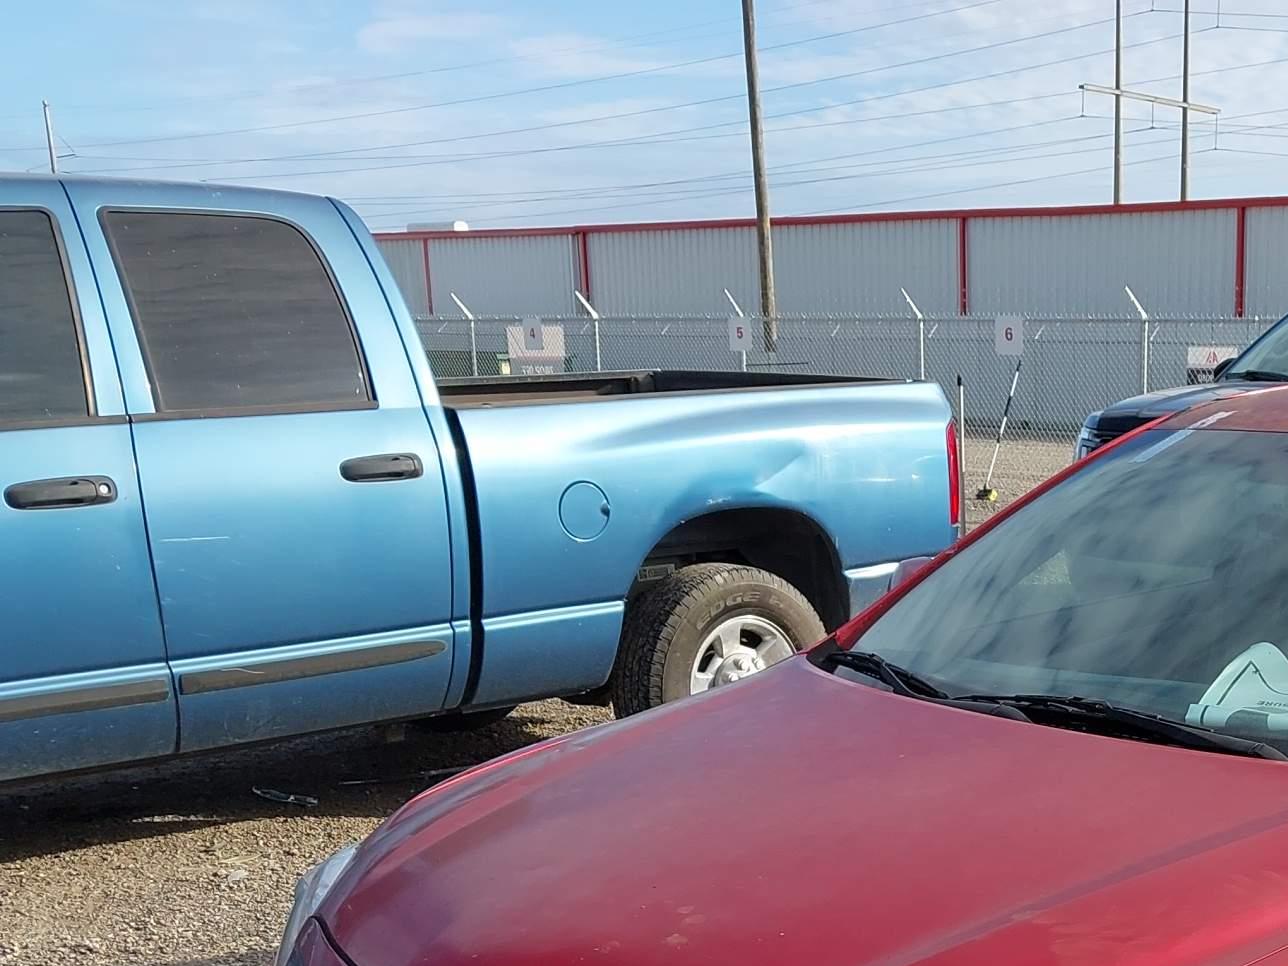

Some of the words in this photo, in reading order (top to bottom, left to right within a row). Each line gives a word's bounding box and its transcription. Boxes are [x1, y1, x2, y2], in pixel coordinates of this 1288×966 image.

[736, 326, 744, 340] 5
[1004, 326, 1013, 342] 6
[696, 591, 761, 630] EDGE
